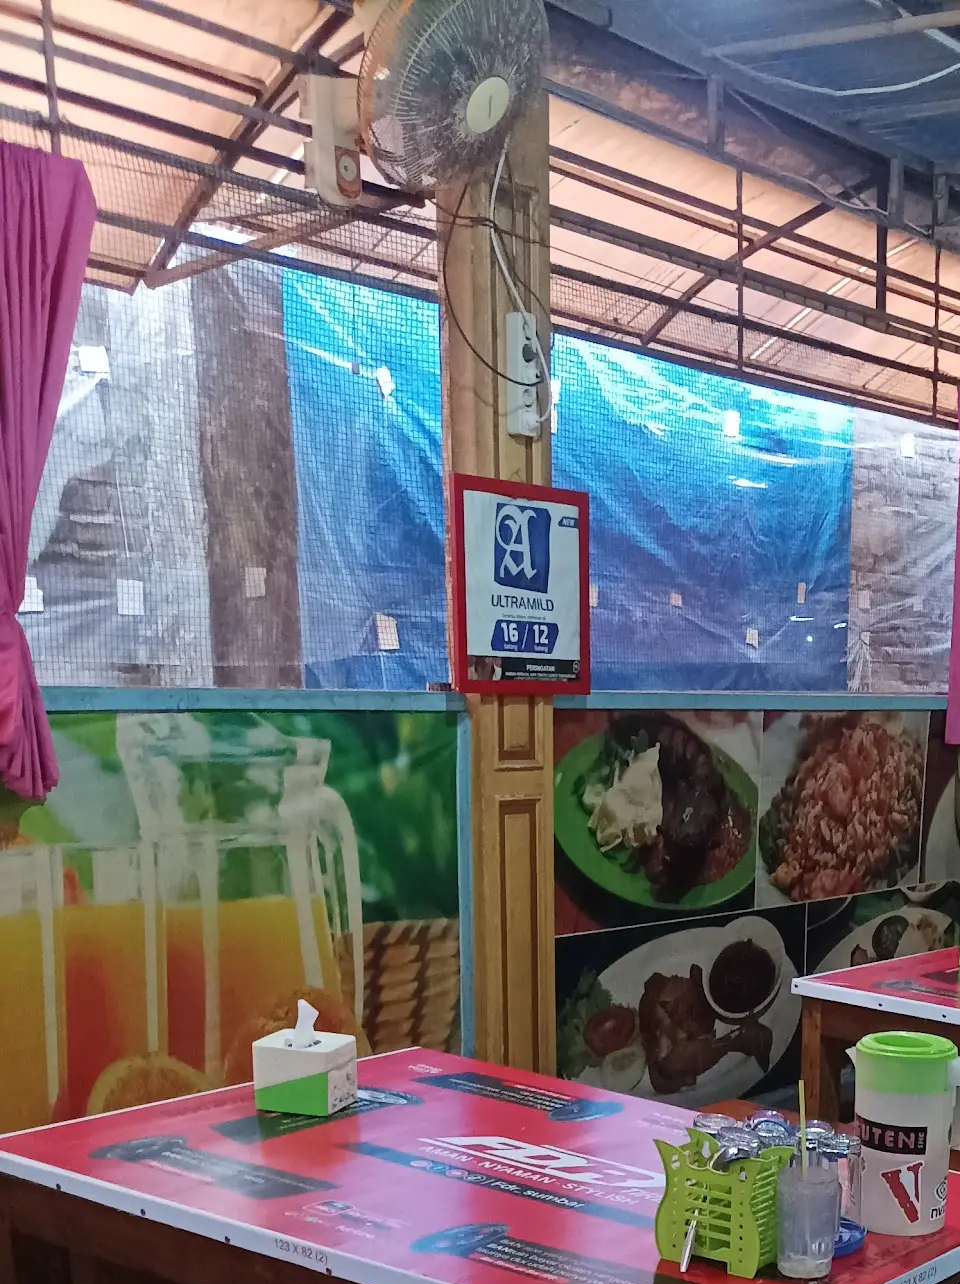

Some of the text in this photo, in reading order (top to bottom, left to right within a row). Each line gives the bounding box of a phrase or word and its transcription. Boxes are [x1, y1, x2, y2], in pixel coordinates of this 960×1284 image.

[561, 517, 576, 527] NEW
[491, 594, 555, 612] ULTRAMILD
[501, 622, 519, 643] 16
[533, 624, 549, 644] 12
[419, 1146, 641, 1205] AMAN NYAMAN STYLISH
[274, 1238, 328, 1266] 123 X 82 (2)
